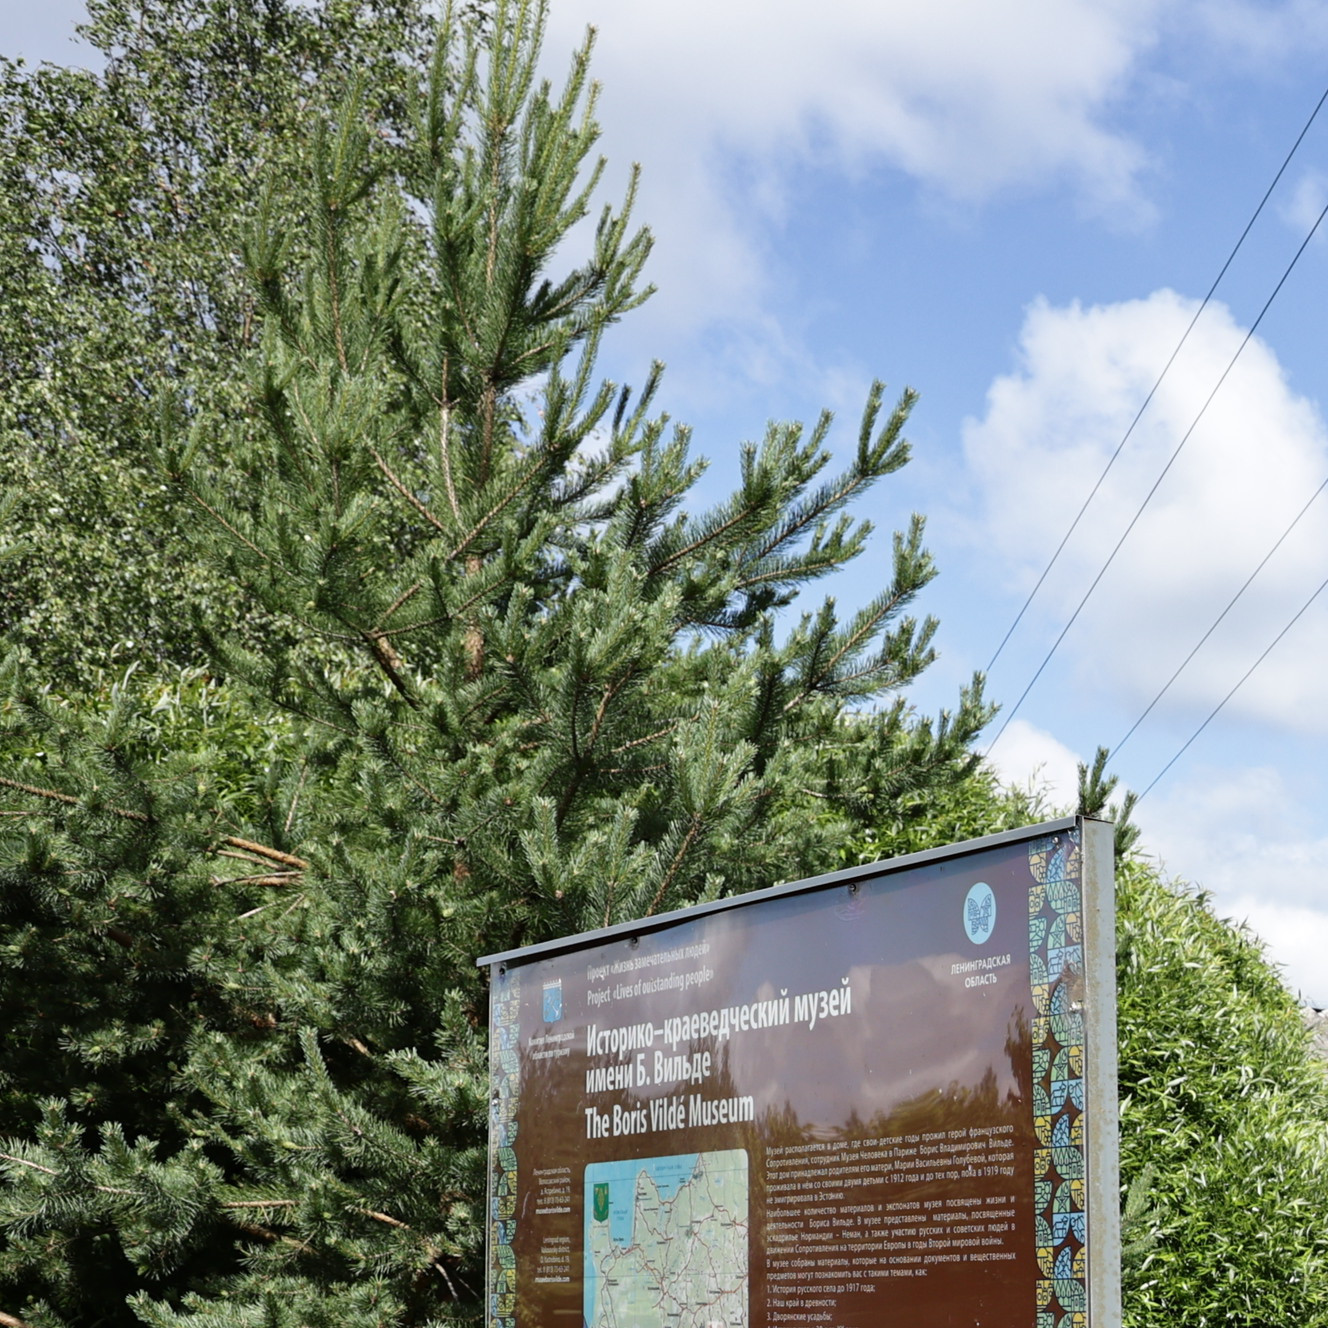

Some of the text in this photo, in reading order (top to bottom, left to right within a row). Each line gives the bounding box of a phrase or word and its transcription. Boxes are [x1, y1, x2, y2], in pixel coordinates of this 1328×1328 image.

[587, 940, 710, 983] Проект «Жизнь замечательных людей»
[950, 954, 1010, 975] ЛЕНИНГРАДСКАЯ
[587, 964, 714, 1008] Project «Lives of outstanding people»
[964, 973, 997, 988] ОБЛАСТЬ
[794, 978, 851, 1030] музей
[586, 1050, 711, 1093] имени Б. Вильде
[585, 1094, 754, 1139] The Boris Vildé Museum
[772, 1261, 789, 1269] музее
[790, 1258, 815, 1268] собраны
[817, 1259, 850, 1268] материалы,
[852, 1258, 877, 1267] которые
[888, 1256, 921, 1264] основании
[923, 1254, 961, 1264] документов
[969, 1252, 1016, 1262] вещественных
[767, 1273, 796, 1281] предметов
[797, 1272, 813, 1280] могут
[773, 1285, 796, 1295] История
[797, 1286, 822, 1295] русского
[846, 1283, 859, 1292] 1917
[773, 1298, 784, 1307] Наш
[786, 1298, 799, 1308] край
[773, 1311, 806, 1322] Дворянские
